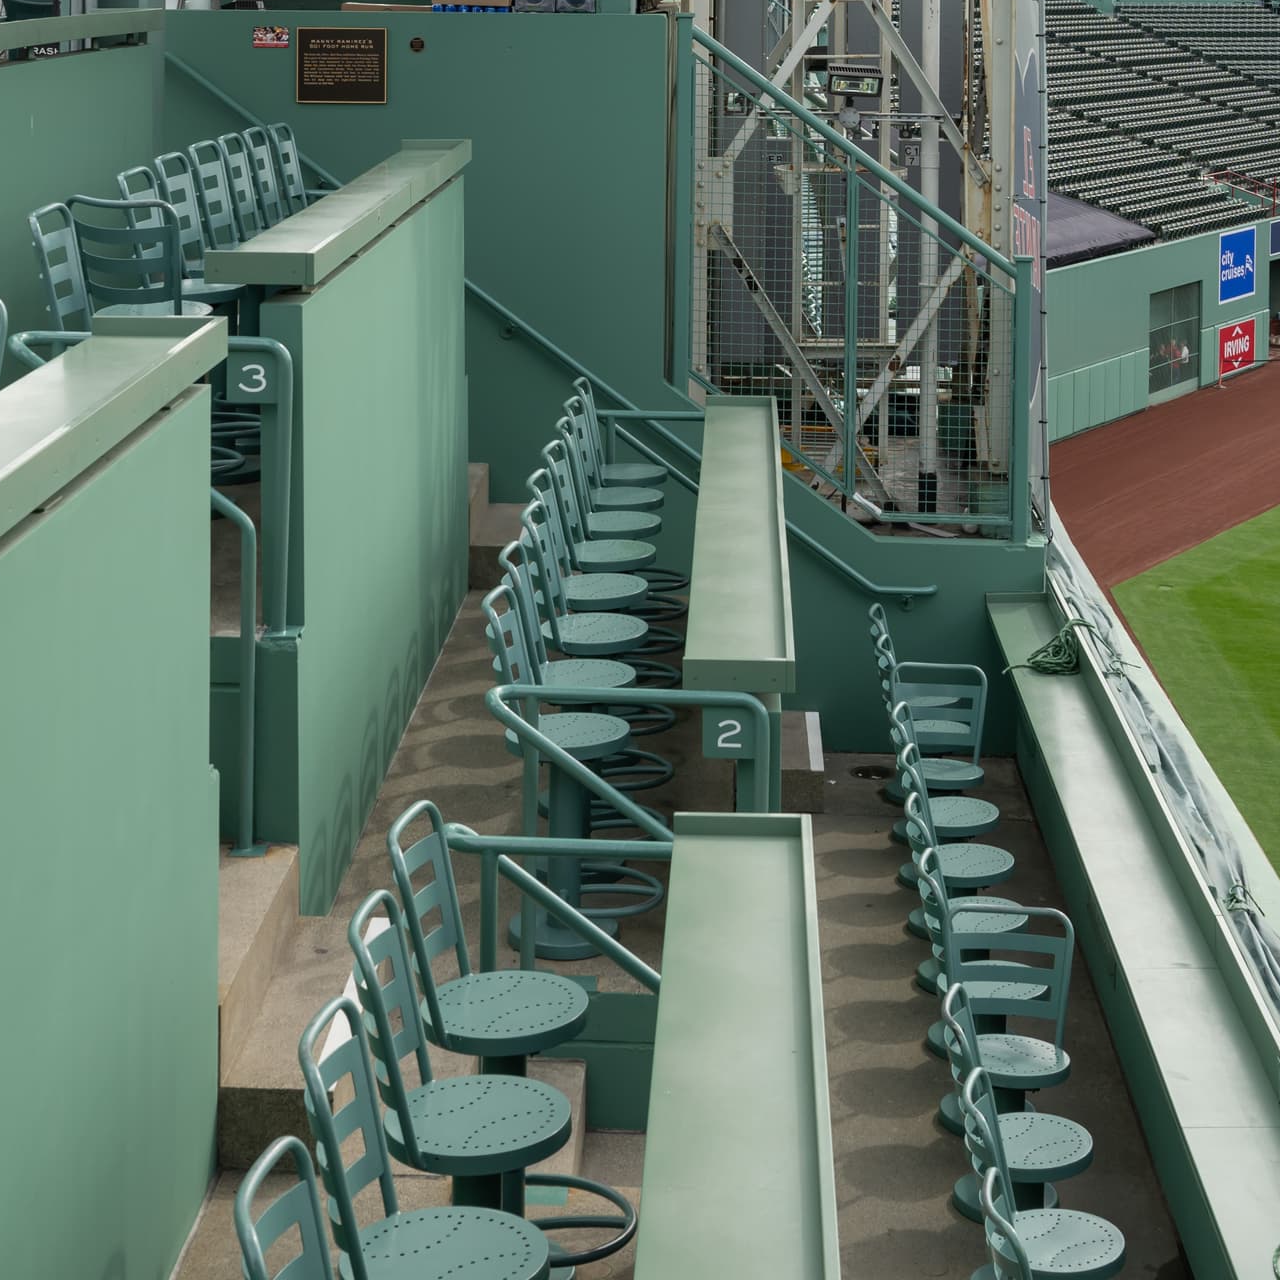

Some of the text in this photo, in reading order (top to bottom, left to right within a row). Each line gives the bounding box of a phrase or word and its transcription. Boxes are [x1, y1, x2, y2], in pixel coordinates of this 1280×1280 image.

[1221, 249, 1235, 268] city
[1221, 264, 1245, 282] cruises
[1223, 335, 1250, 359] IRVING
[238, 363, 268, 393] 3
[717, 719, 742, 748] 2
